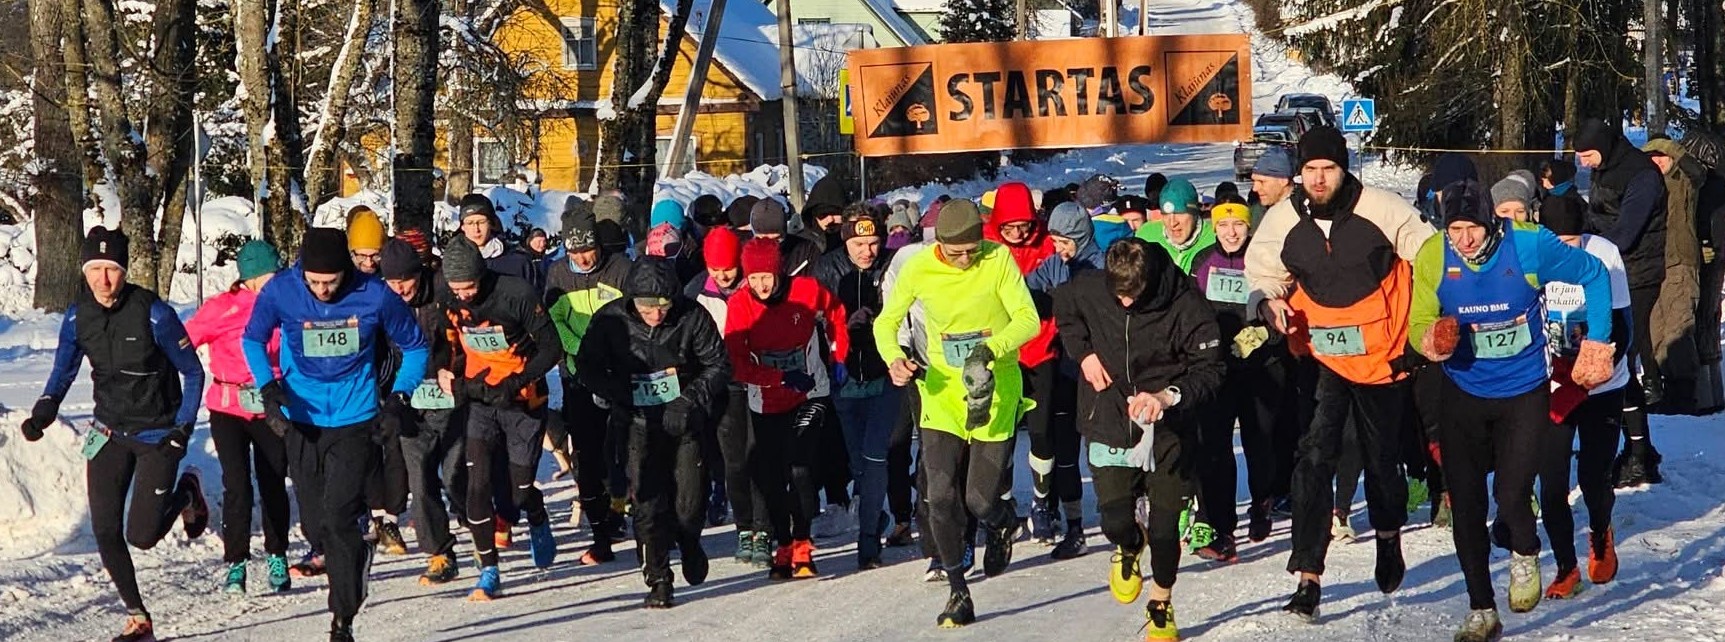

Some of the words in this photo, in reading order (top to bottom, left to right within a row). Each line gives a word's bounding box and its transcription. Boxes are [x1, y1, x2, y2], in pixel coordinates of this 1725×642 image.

[947, 65, 1155, 121] STARTAS
[858, 222, 874, 235] Buff
[1219, 278, 1243, 293] 112
[1458, 304, 1488, 314] KAUNO
[1490, 302, 1510, 312] BMK
[318, 332, 347, 346] 148
[474, 336, 499, 348] 118
[1326, 331, 1347, 345] 94
[1486, 330, 1517, 348] 127
[421, 387, 445, 399] 142
[644, 382, 669, 396] 123
